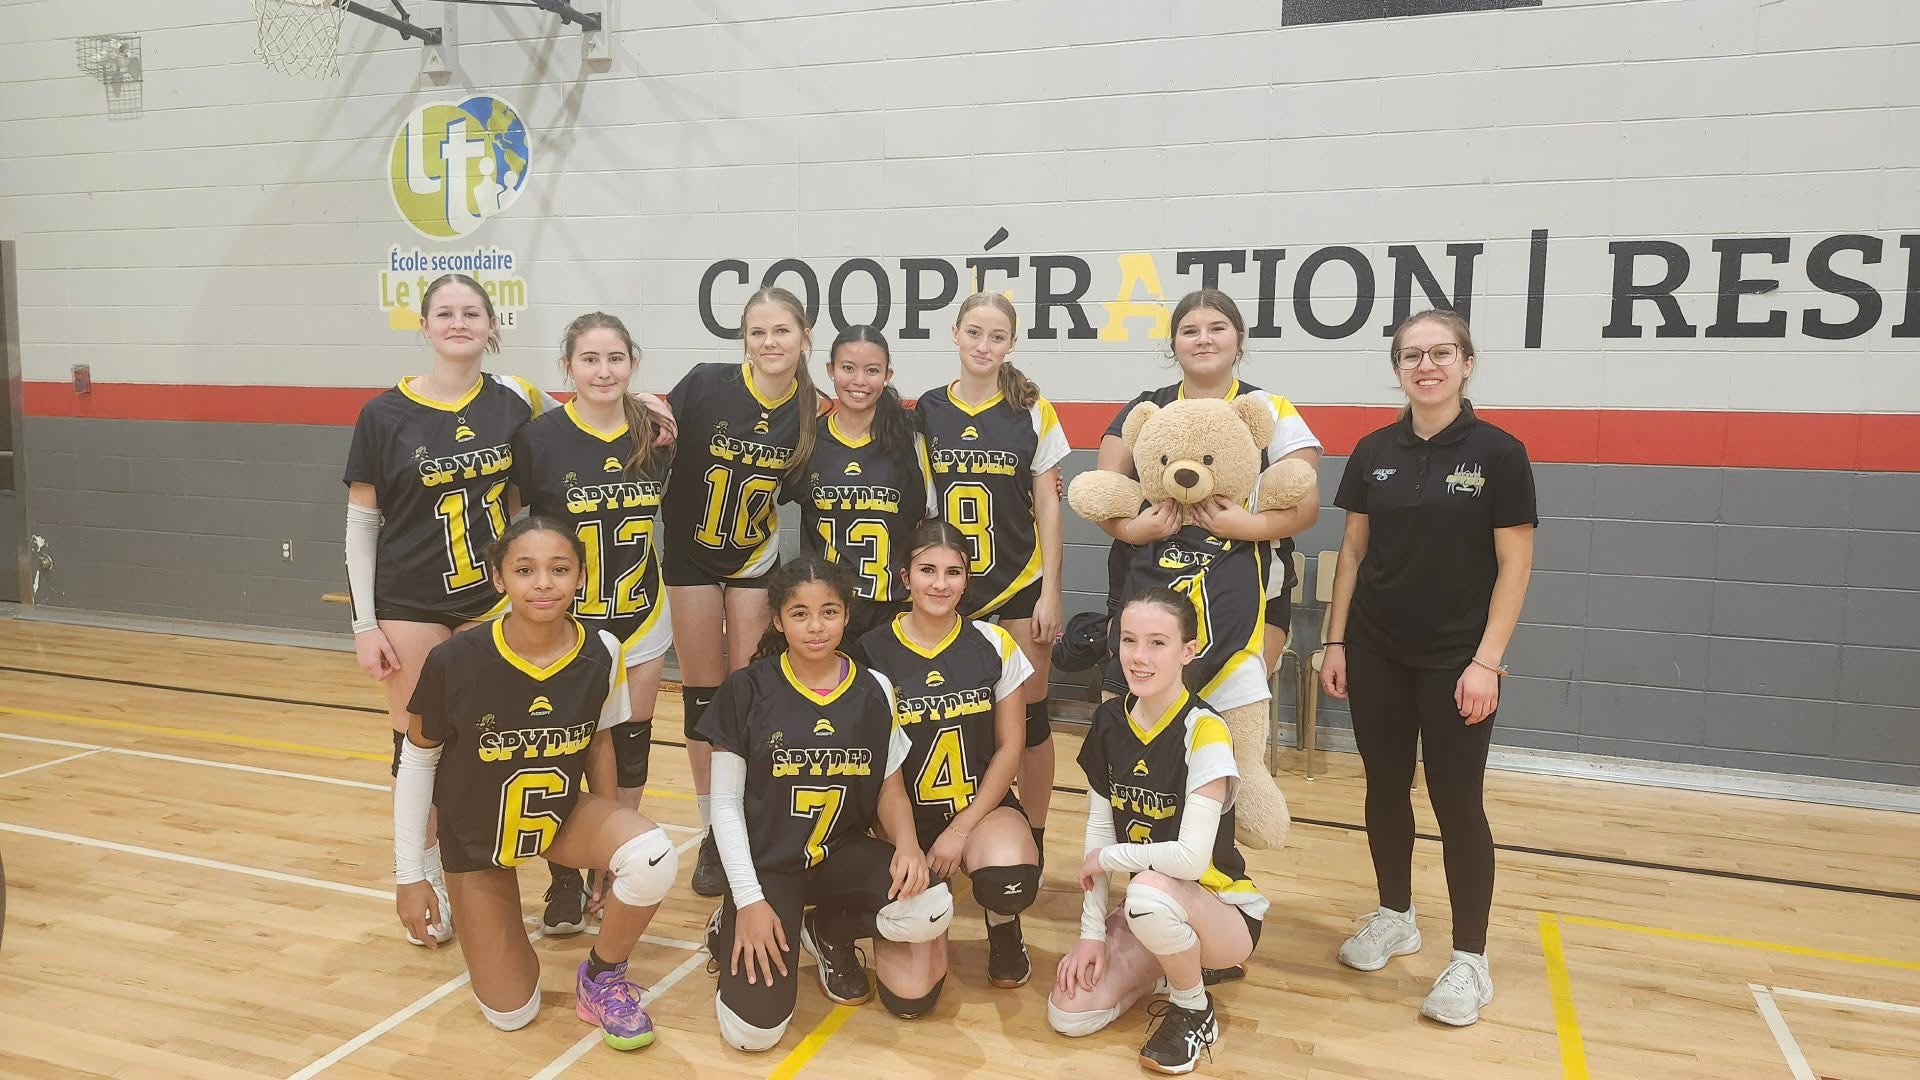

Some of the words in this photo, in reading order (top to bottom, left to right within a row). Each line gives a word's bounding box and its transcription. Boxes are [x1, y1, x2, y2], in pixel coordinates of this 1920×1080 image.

[381, 272, 410, 307] Le
[391, 248, 428, 271] École
[431, 249, 513, 271] secondaire
[419, 443, 513, 487] SPYDE
[931, 449, 1019, 477] SPYDER
[694, 464, 779, 549] 10
[812, 485, 901, 514] SPYDER
[944, 481, 996, 576] 8
[434, 476, 510, 595] 11
[573, 515, 654, 619] 12
[816, 517, 893, 602] 13
[897, 687, 992, 726] SPYDER
[478, 720, 596, 763] SPYDER
[772, 748, 872, 777] SPYDER
[914, 725, 978, 820] 4
[492, 766, 570, 868] 6
[790, 784, 847, 870] 7
